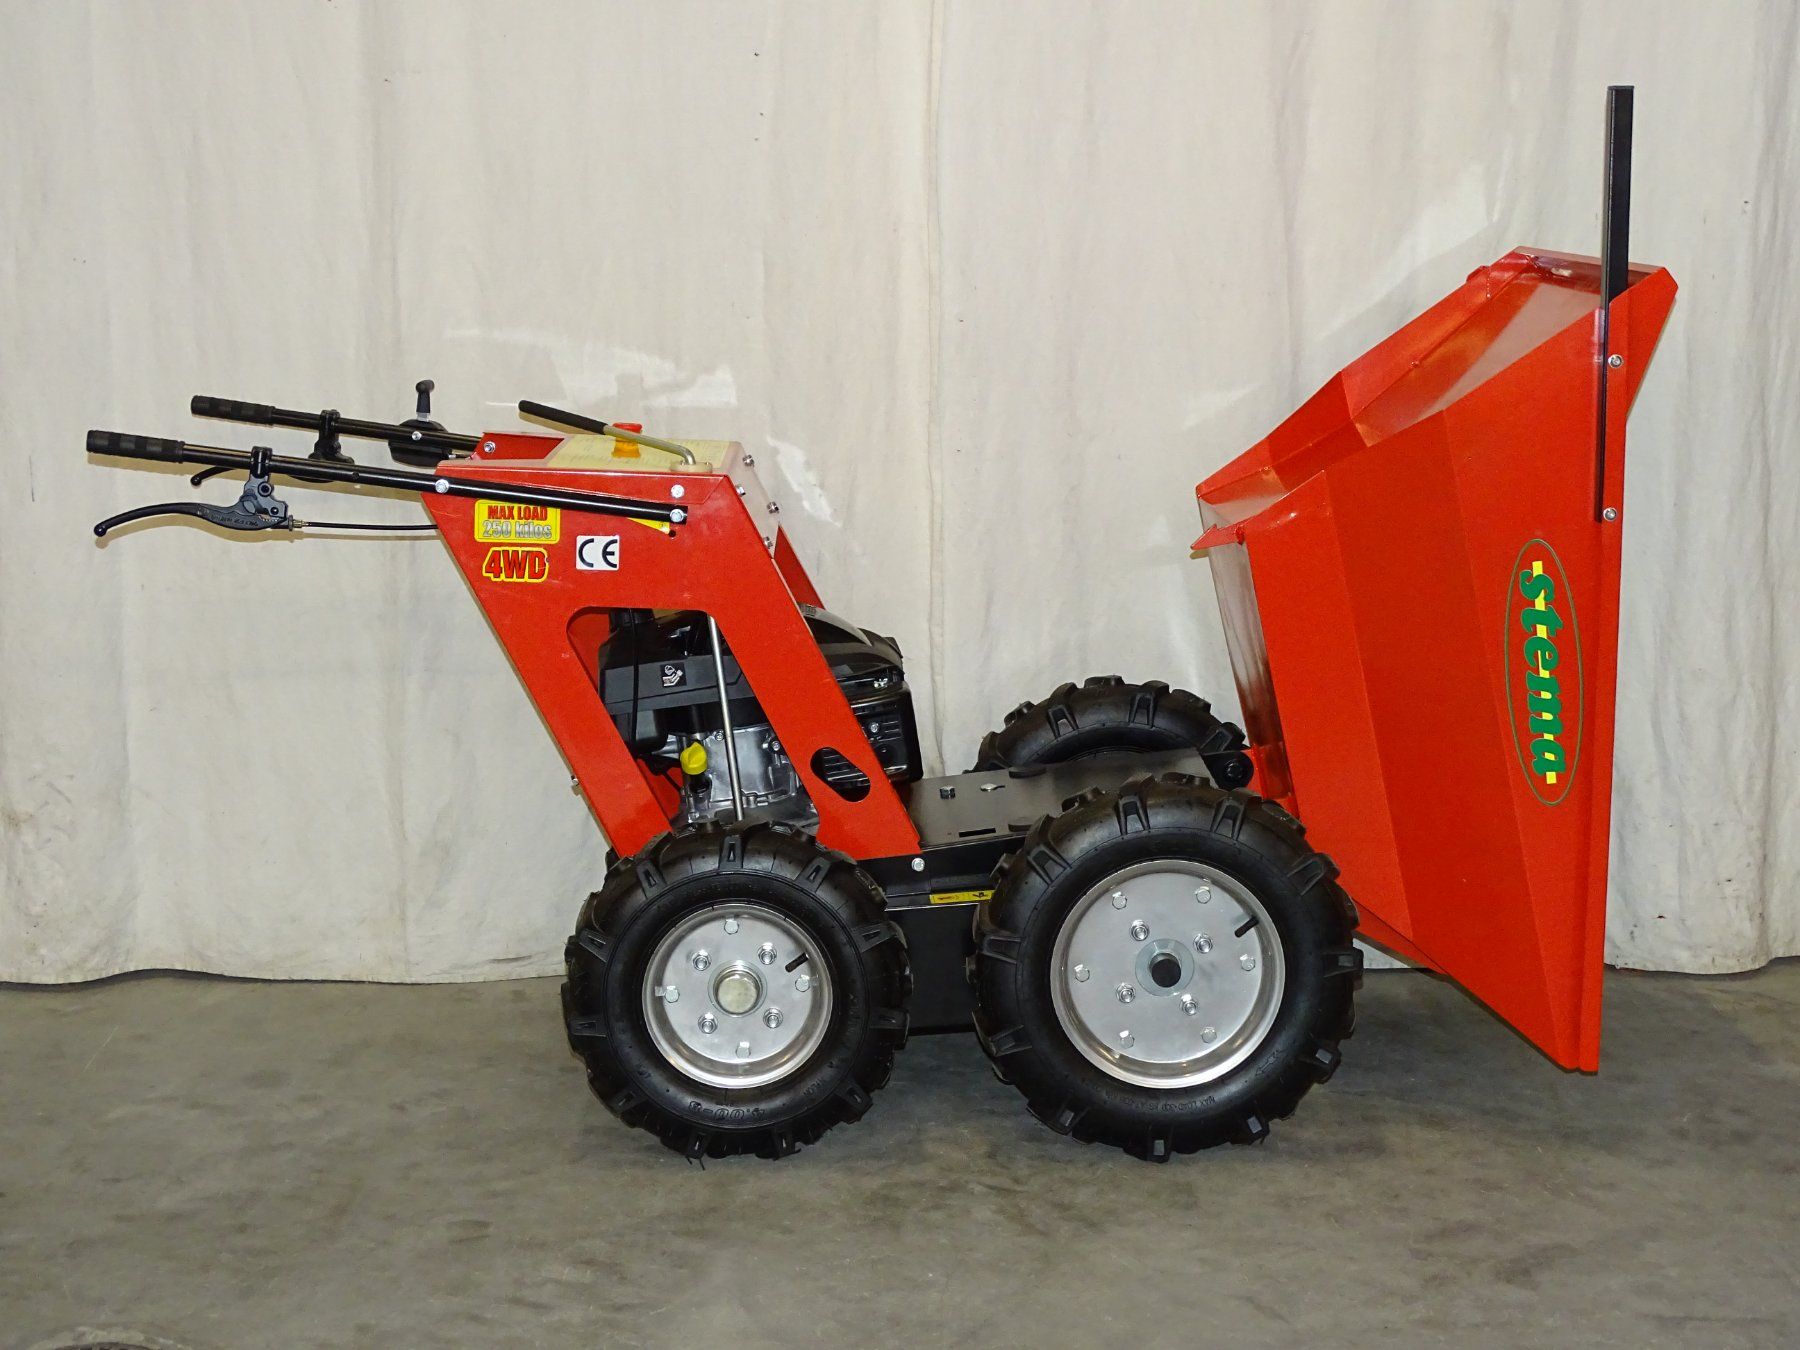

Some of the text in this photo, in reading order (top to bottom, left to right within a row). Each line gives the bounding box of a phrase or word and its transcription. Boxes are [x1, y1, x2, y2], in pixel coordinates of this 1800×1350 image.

[487, 504, 548, 521] MAX LOAD
[482, 519, 552, 539] 250 kilos
[484, 549, 547, 581] 4WD
[578, 537, 618, 568] CE
[1519, 565, 1567, 781] stema
